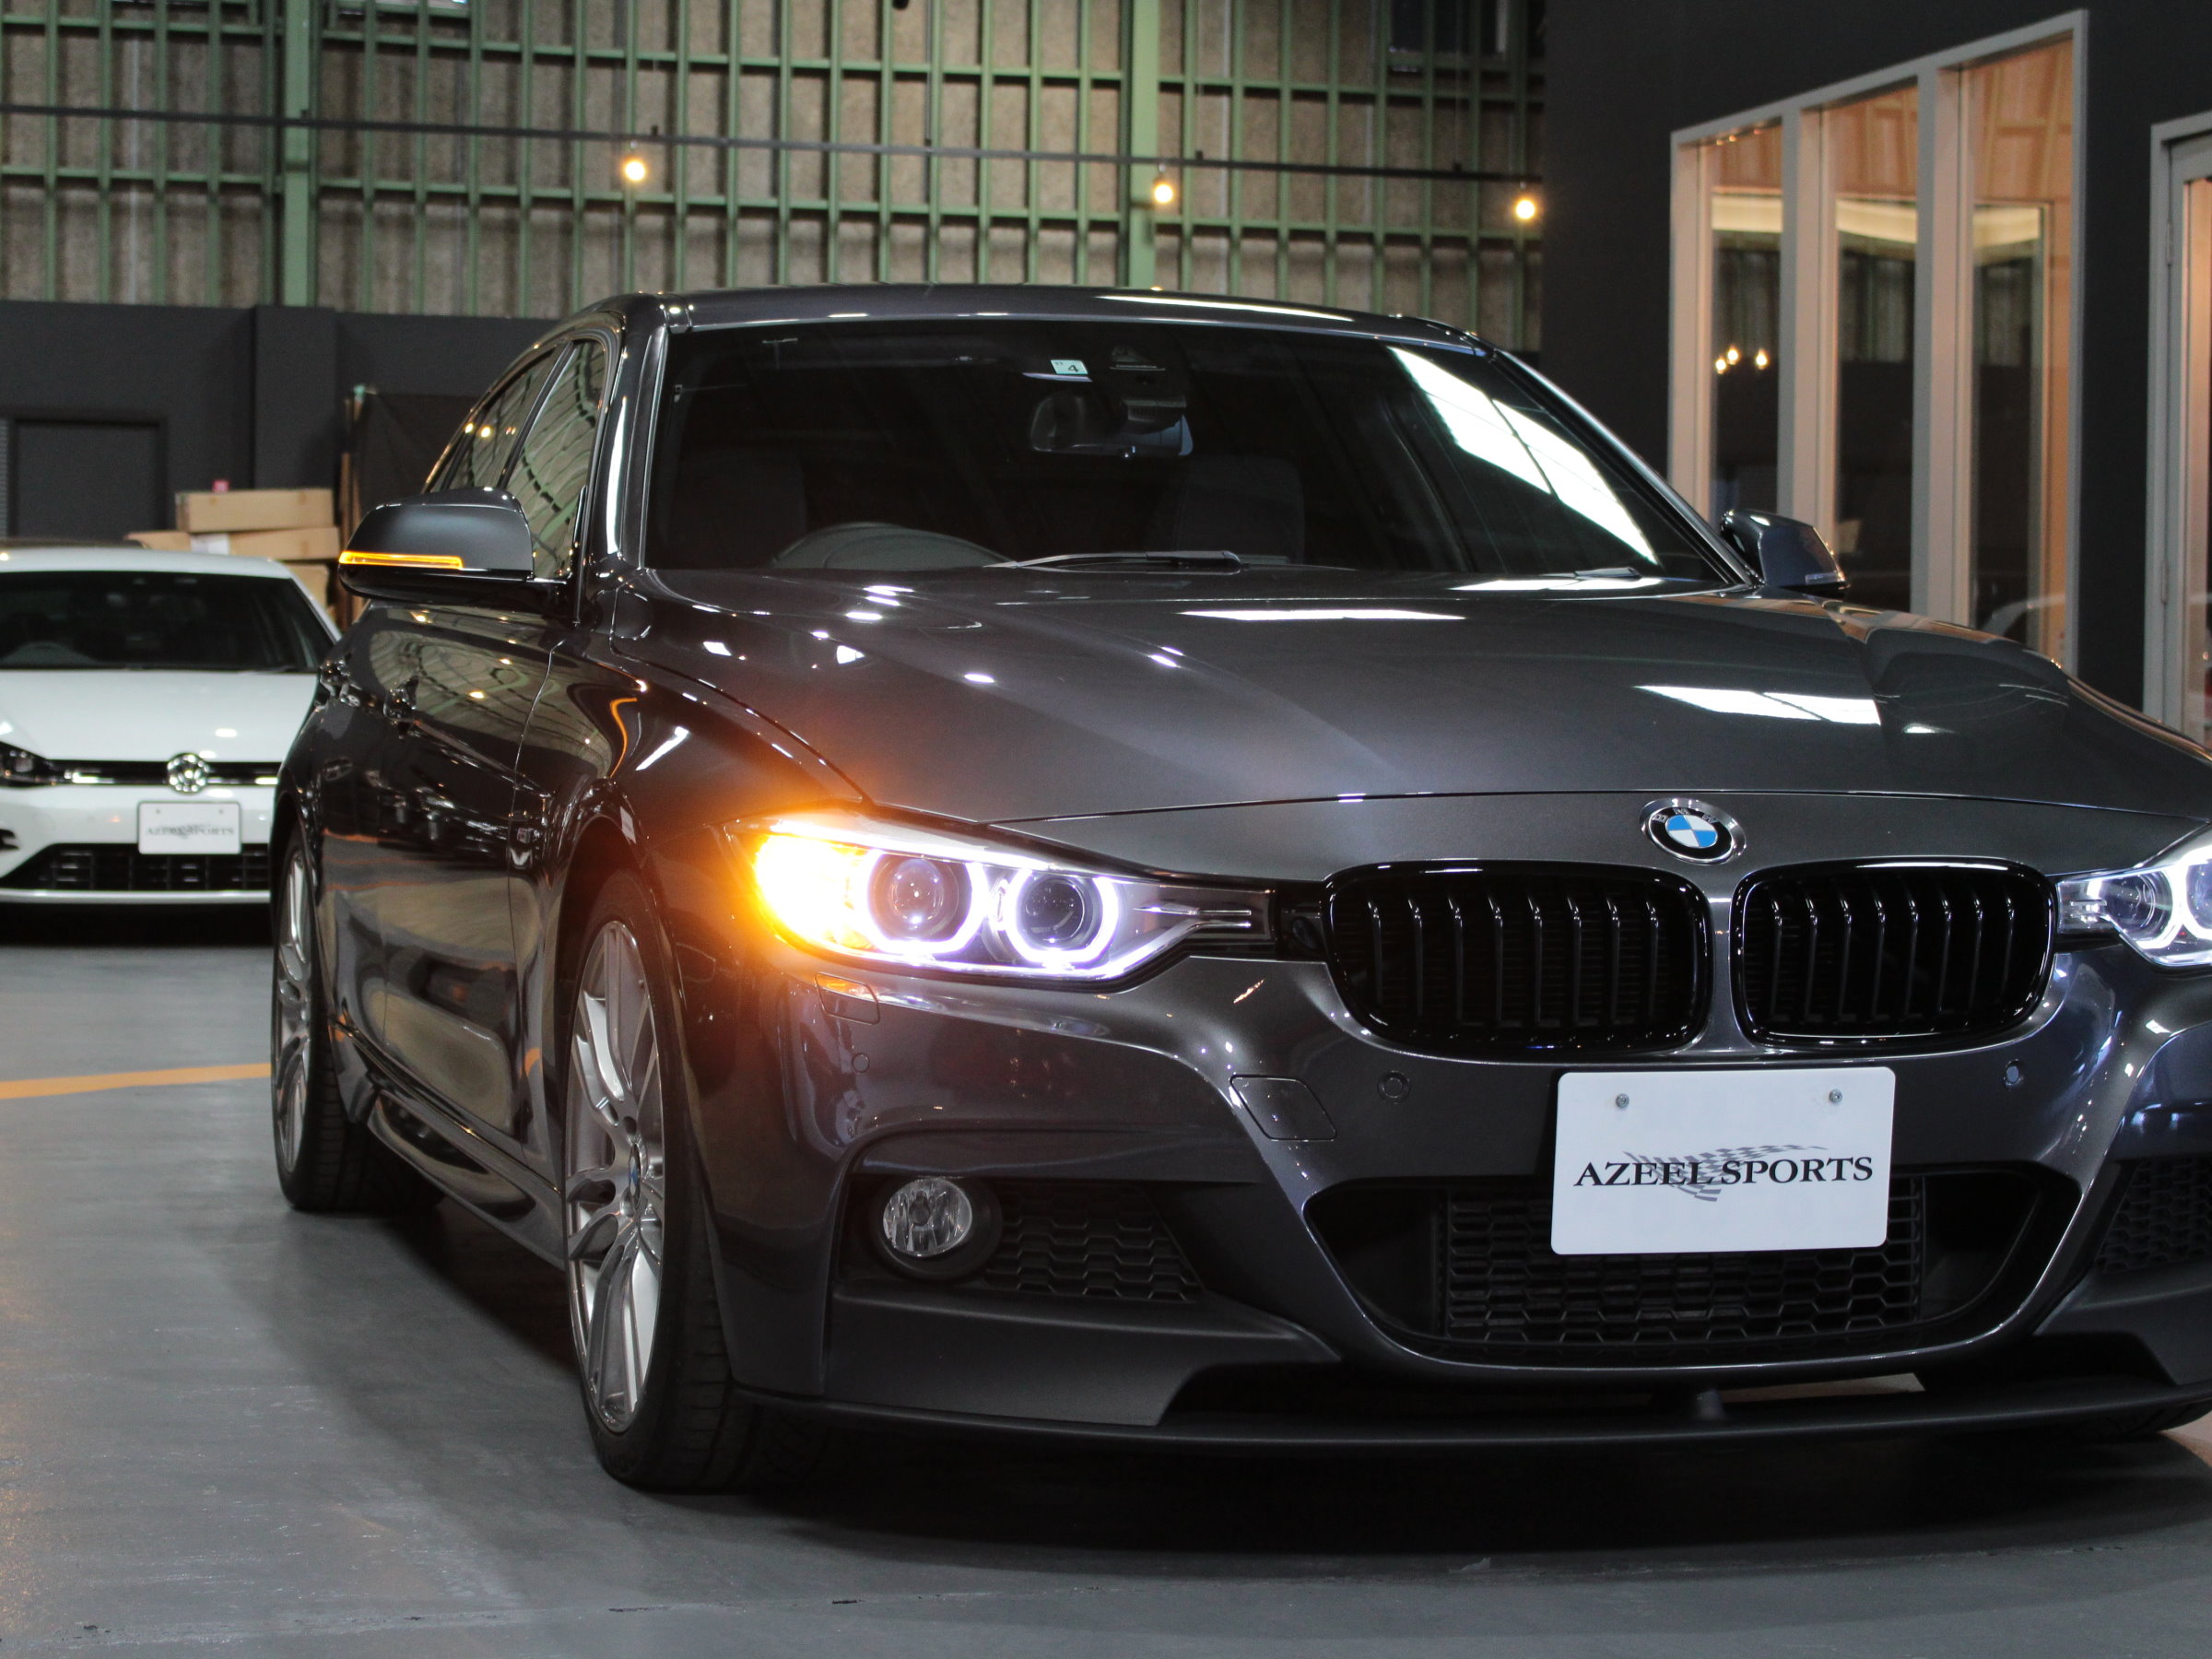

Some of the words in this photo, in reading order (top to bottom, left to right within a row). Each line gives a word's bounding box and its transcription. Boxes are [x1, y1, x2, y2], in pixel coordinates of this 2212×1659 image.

[1067, 364, 1079, 372] 4
[1652, 807, 1718, 824] BMW
[1573, 1160, 1715, 1186] AZEEL
[1721, 1156, 1874, 1184] SPORTS
